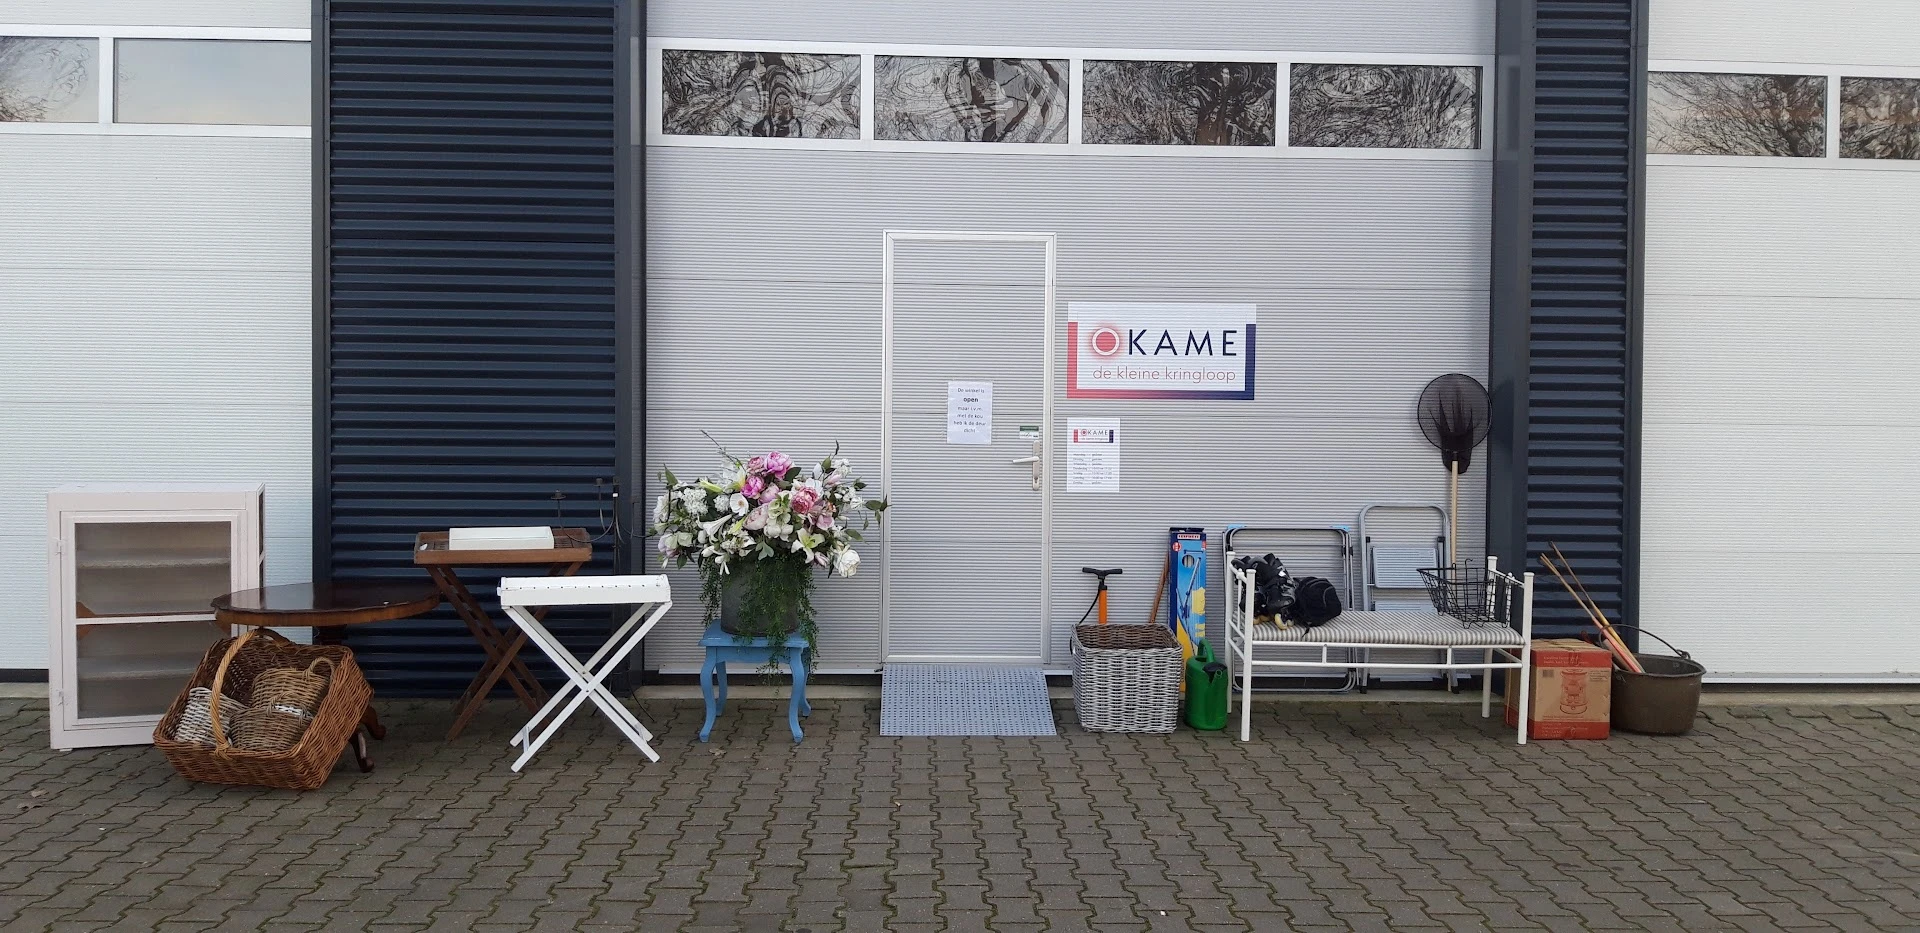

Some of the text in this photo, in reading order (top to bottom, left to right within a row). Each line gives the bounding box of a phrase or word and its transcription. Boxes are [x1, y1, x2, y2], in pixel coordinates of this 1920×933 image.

[1091, 327, 1238, 357] OKAME
[1092, 365, 1237, 384] de kleine kringloop
